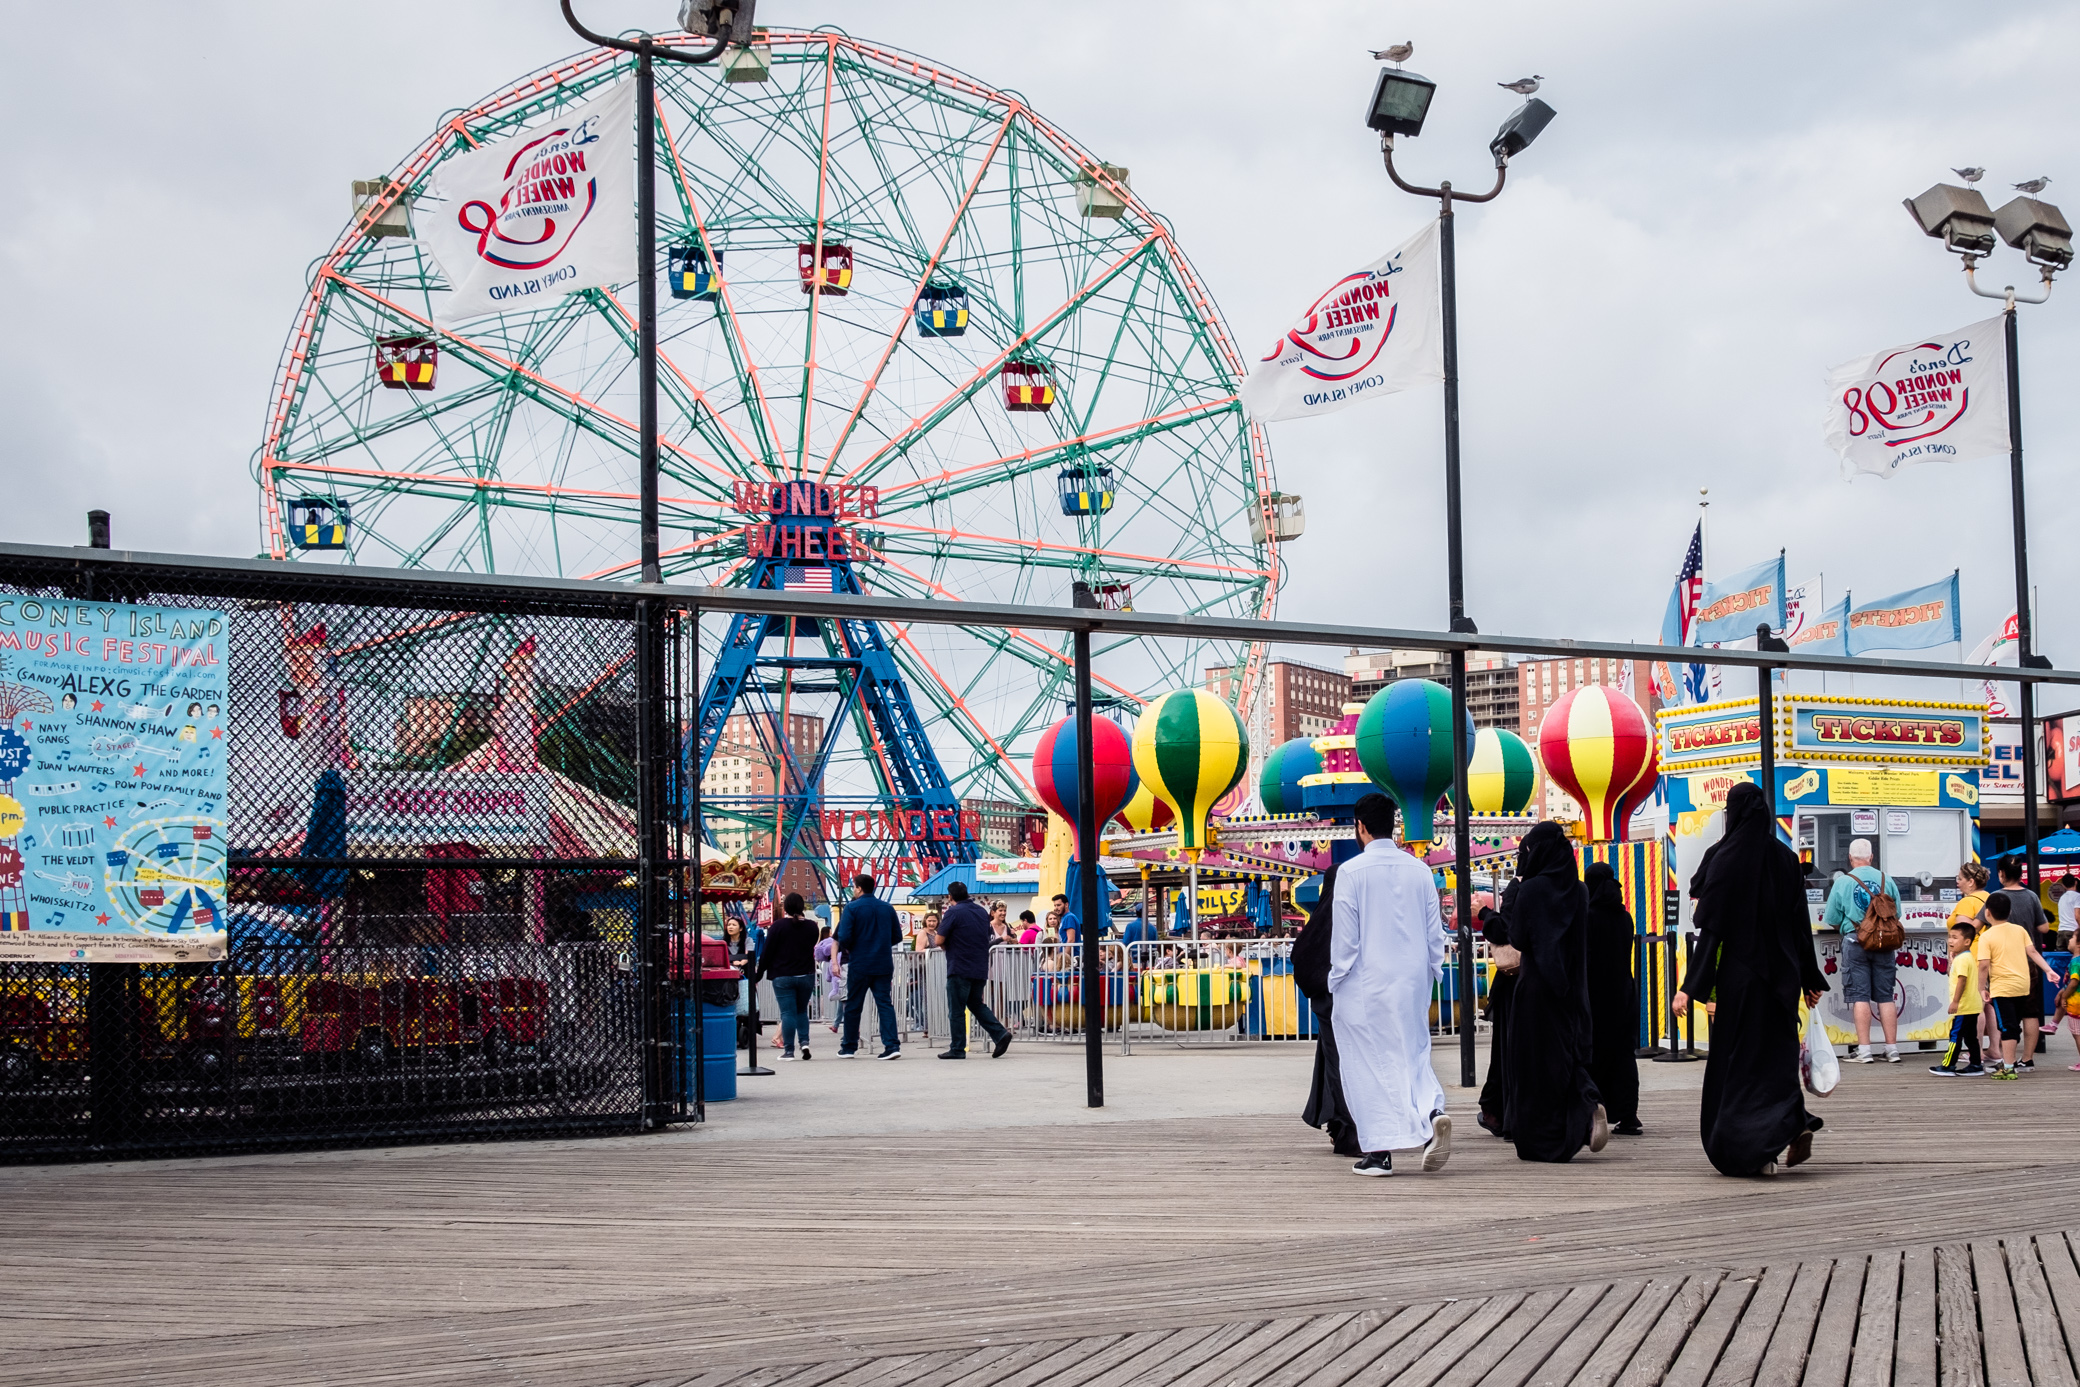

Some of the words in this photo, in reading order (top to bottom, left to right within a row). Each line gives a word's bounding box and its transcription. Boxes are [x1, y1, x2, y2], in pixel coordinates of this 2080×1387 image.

[733, 480, 879, 519] WONDER
[744, 523, 870, 561] WHEEL
[0, 600, 117, 633] CONEY
[130, 610, 223, 640] ISLAND
[0, 630, 91, 658] MUSIC
[103, 637, 220, 668] FESTIVAL
[33, 660, 50, 668] FOR
[50, 661, 80, 672] MORE
[17, 667, 66, 688] (SANDY)
[140, 683, 168, 697] THE
[170, 685, 223, 701] GARDEN
[38, 723, 68, 733] NAVY
[76, 713, 137, 732] SHANNON
[139, 722, 178, 738] SHAW
[1670, 717, 1761, 751] TICKETS
[1814, 717, 1964, 745] TICKETS
[36, 735, 71, 745] GANGS
[95, 742, 103, 751] 2
[106, 740, 136, 752] STAGES
[37, 760, 63, 773] JUAN
[67, 763, 116, 776] WAUTERS
[158, 769, 179, 778] AND
[181, 768, 215, 777] MORE!
[114, 780, 137, 790] POW
[140, 781, 162, 792] POW
[163, 783, 195, 797] FAMILY
[197, 789, 223, 801] BAND
[1703, 777, 1735, 793] WONDER
[1710, 790, 1730, 804] WHE
[38, 805, 72, 817] PUBLIC
[73, 799, 126, 815] PRACTICE
[819, 809, 981, 841] WONDER
[41, 855, 65, 865] THE
[66, 855, 96, 866] VELDT
[980, 861, 999, 874] Say
[71, 880, 90, 890] FUN
[29, 893, 96, 912] WHOISSKITZO
